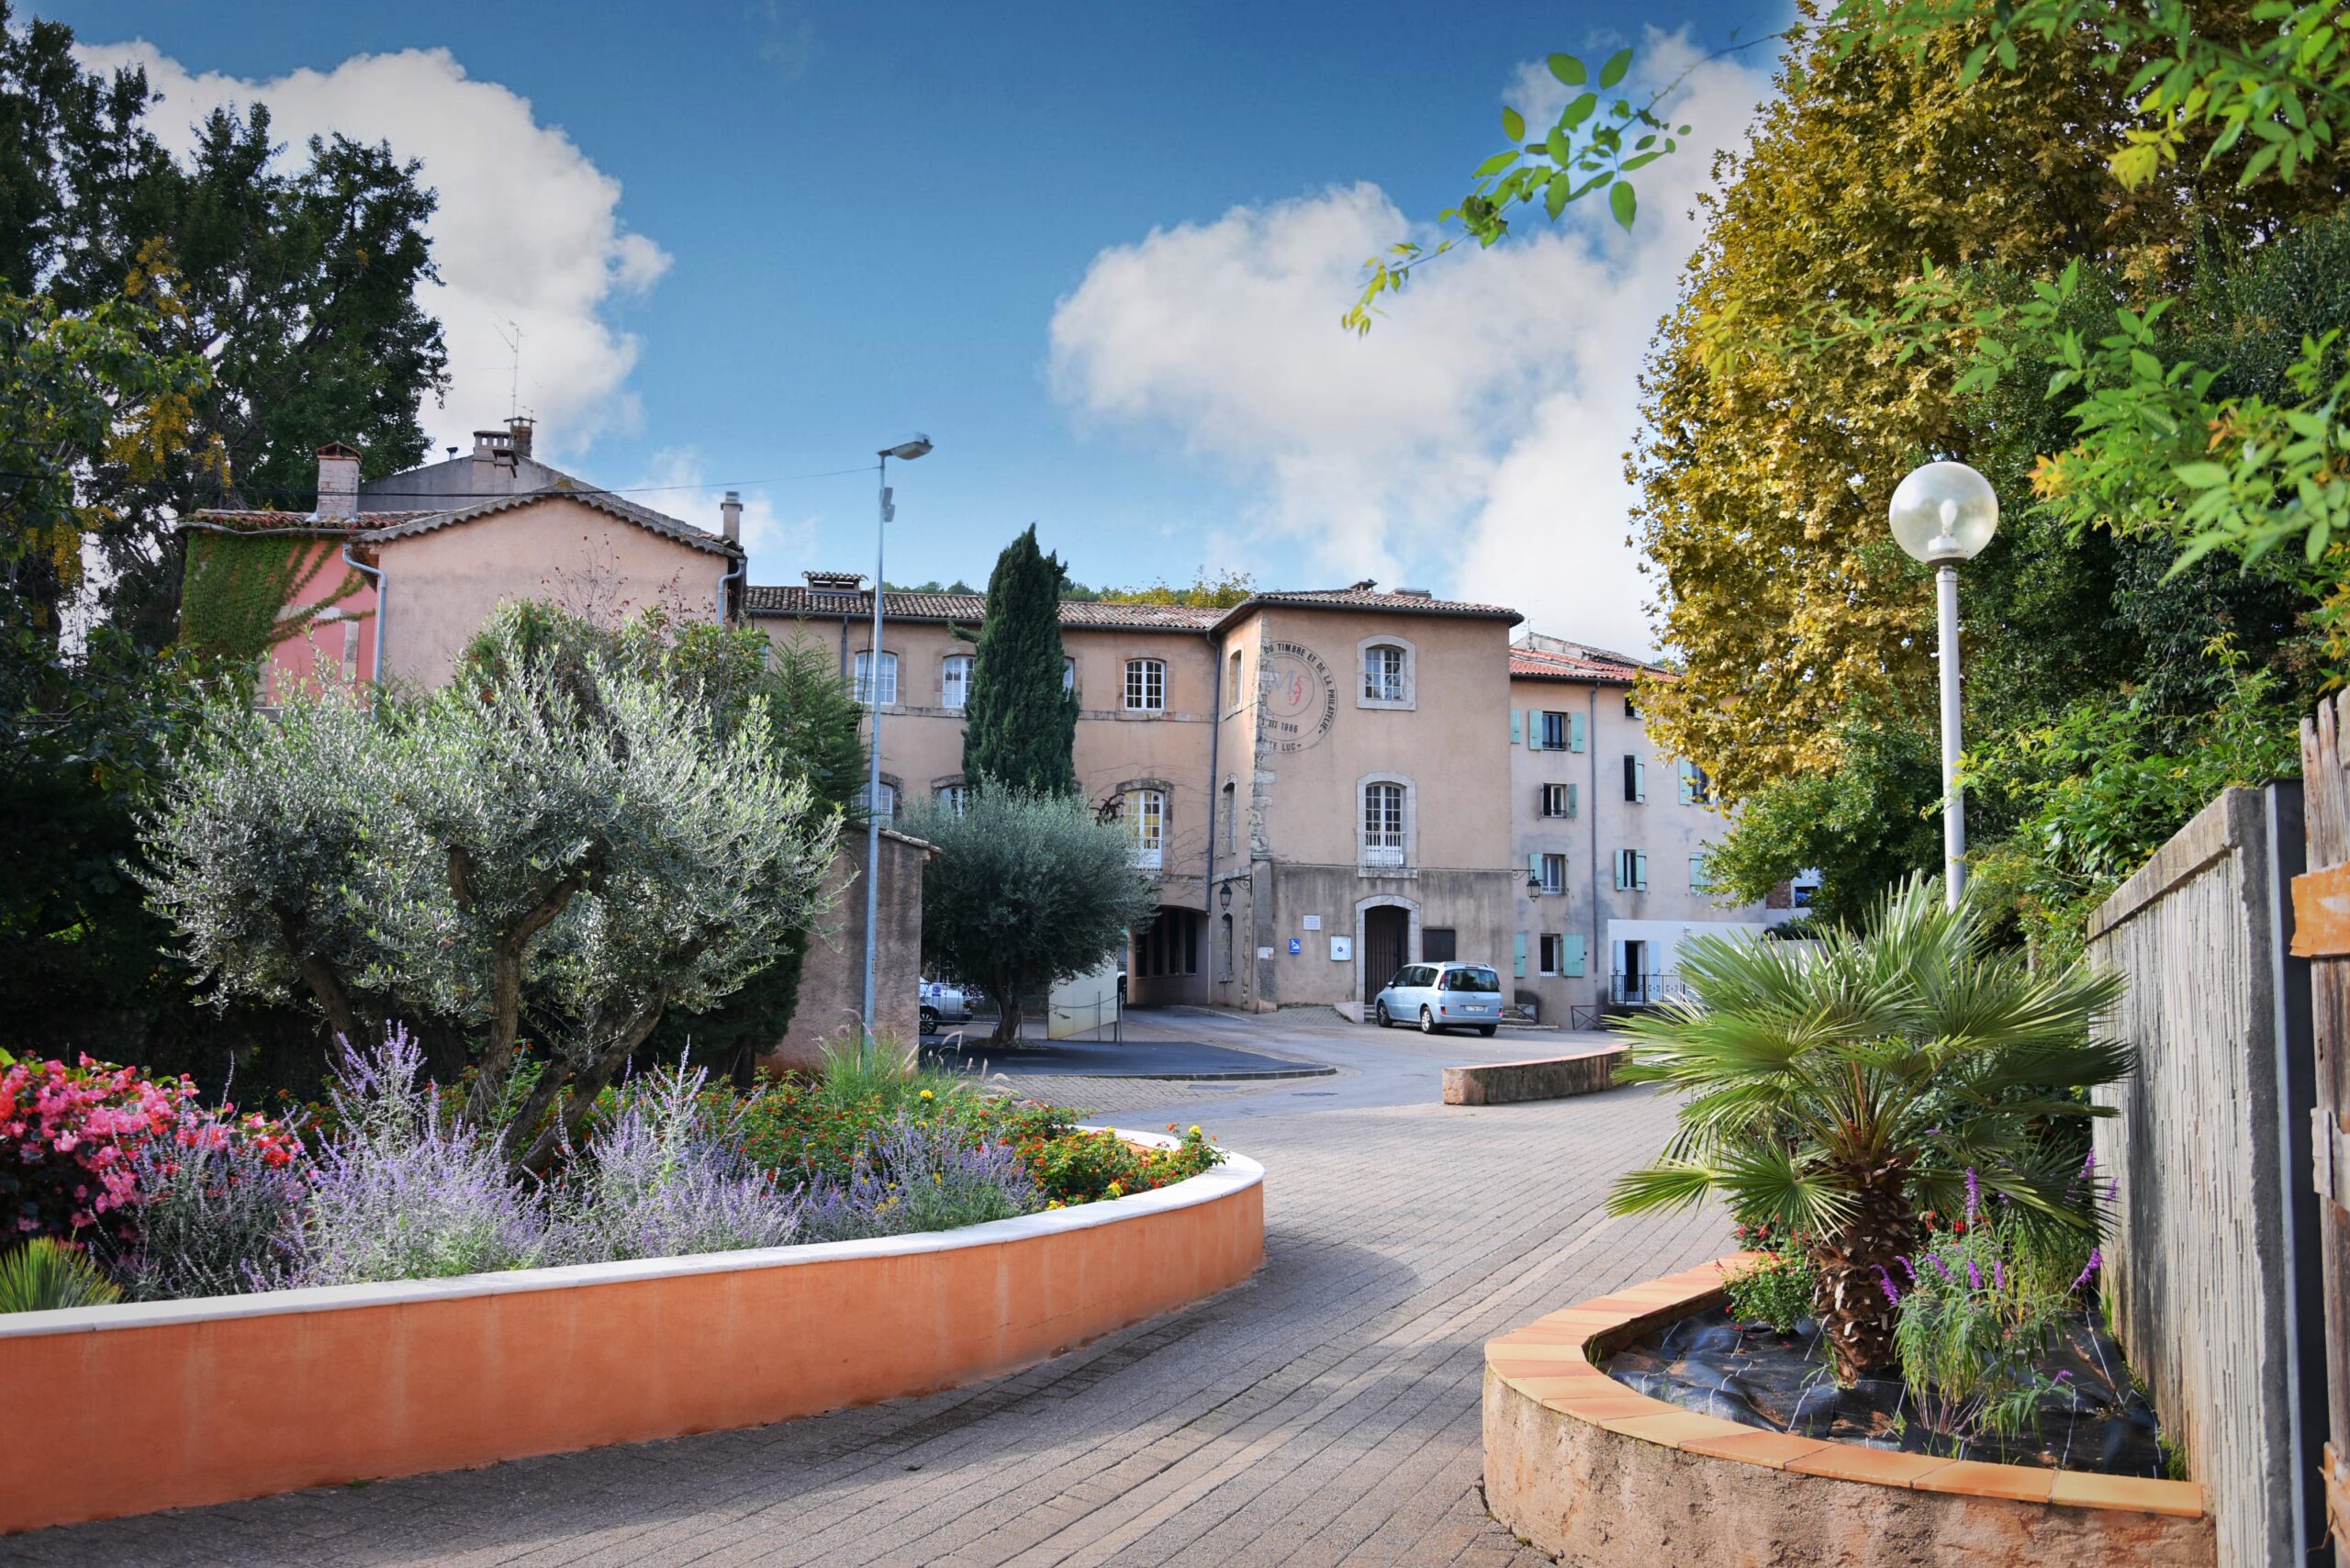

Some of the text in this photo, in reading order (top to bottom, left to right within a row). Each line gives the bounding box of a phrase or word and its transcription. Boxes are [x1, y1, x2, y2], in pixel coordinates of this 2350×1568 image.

[1263, 644, 1274, 654] DU
[1277, 643, 1306, 656] TIMBRE
[1306, 653, 1317, 663] ET
[1315, 662, 1326, 674] DE
[1323, 675, 1333, 687] LA
